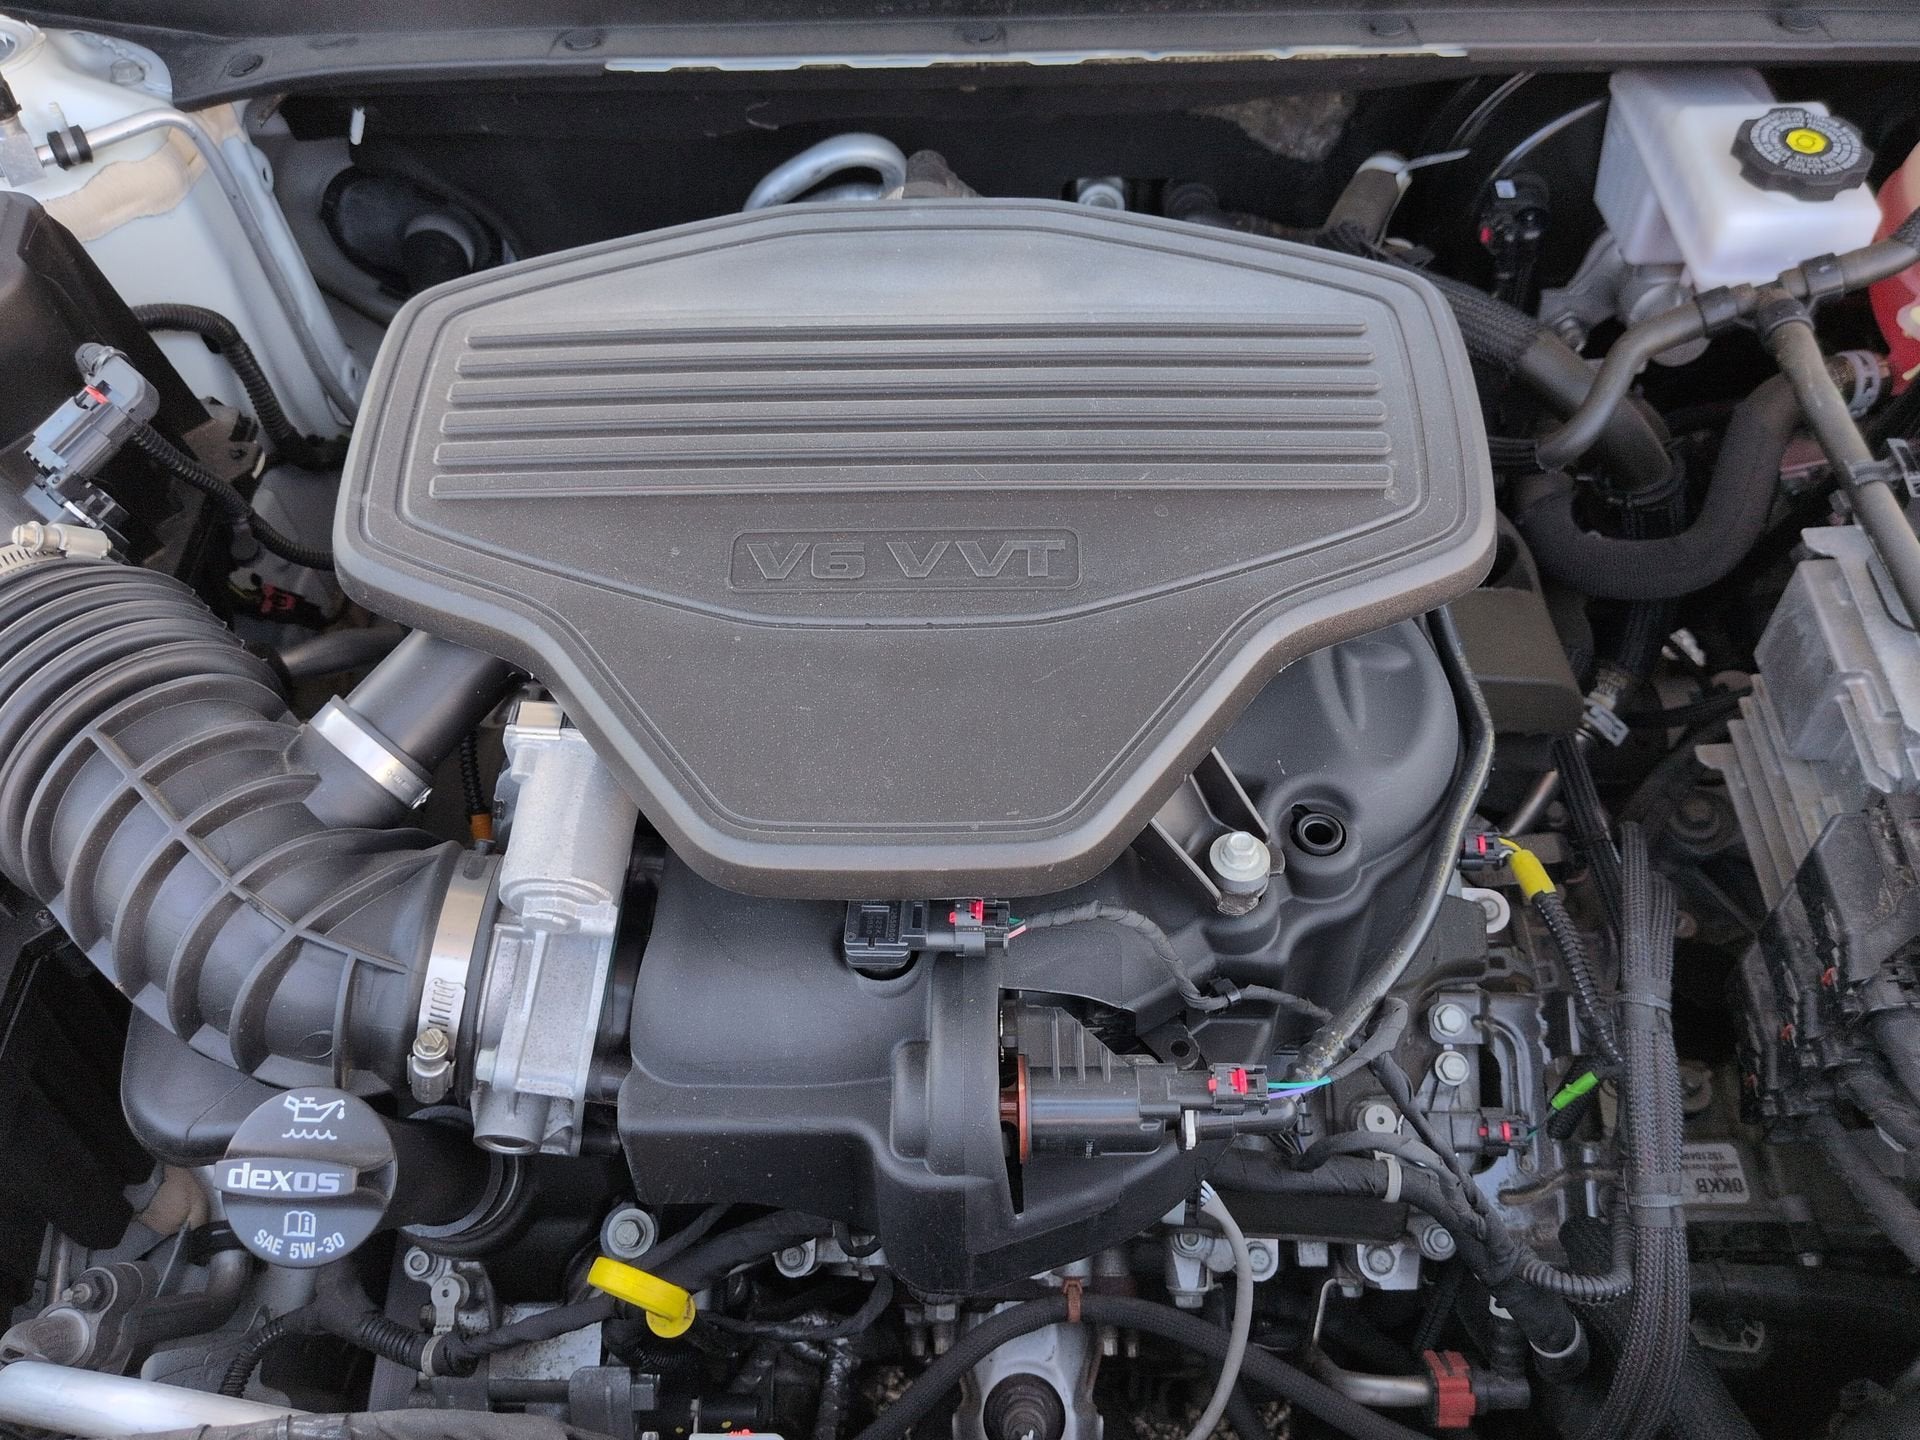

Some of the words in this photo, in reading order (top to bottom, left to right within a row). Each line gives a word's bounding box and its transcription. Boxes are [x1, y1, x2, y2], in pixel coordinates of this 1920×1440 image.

[747, 542, 866, 580] V6
[886, 540, 1066, 579] VVT
[227, 1162, 341, 1193] dexos
[254, 1228, 284, 1256] SAE
[289, 1232, 346, 1260] 5W-30
